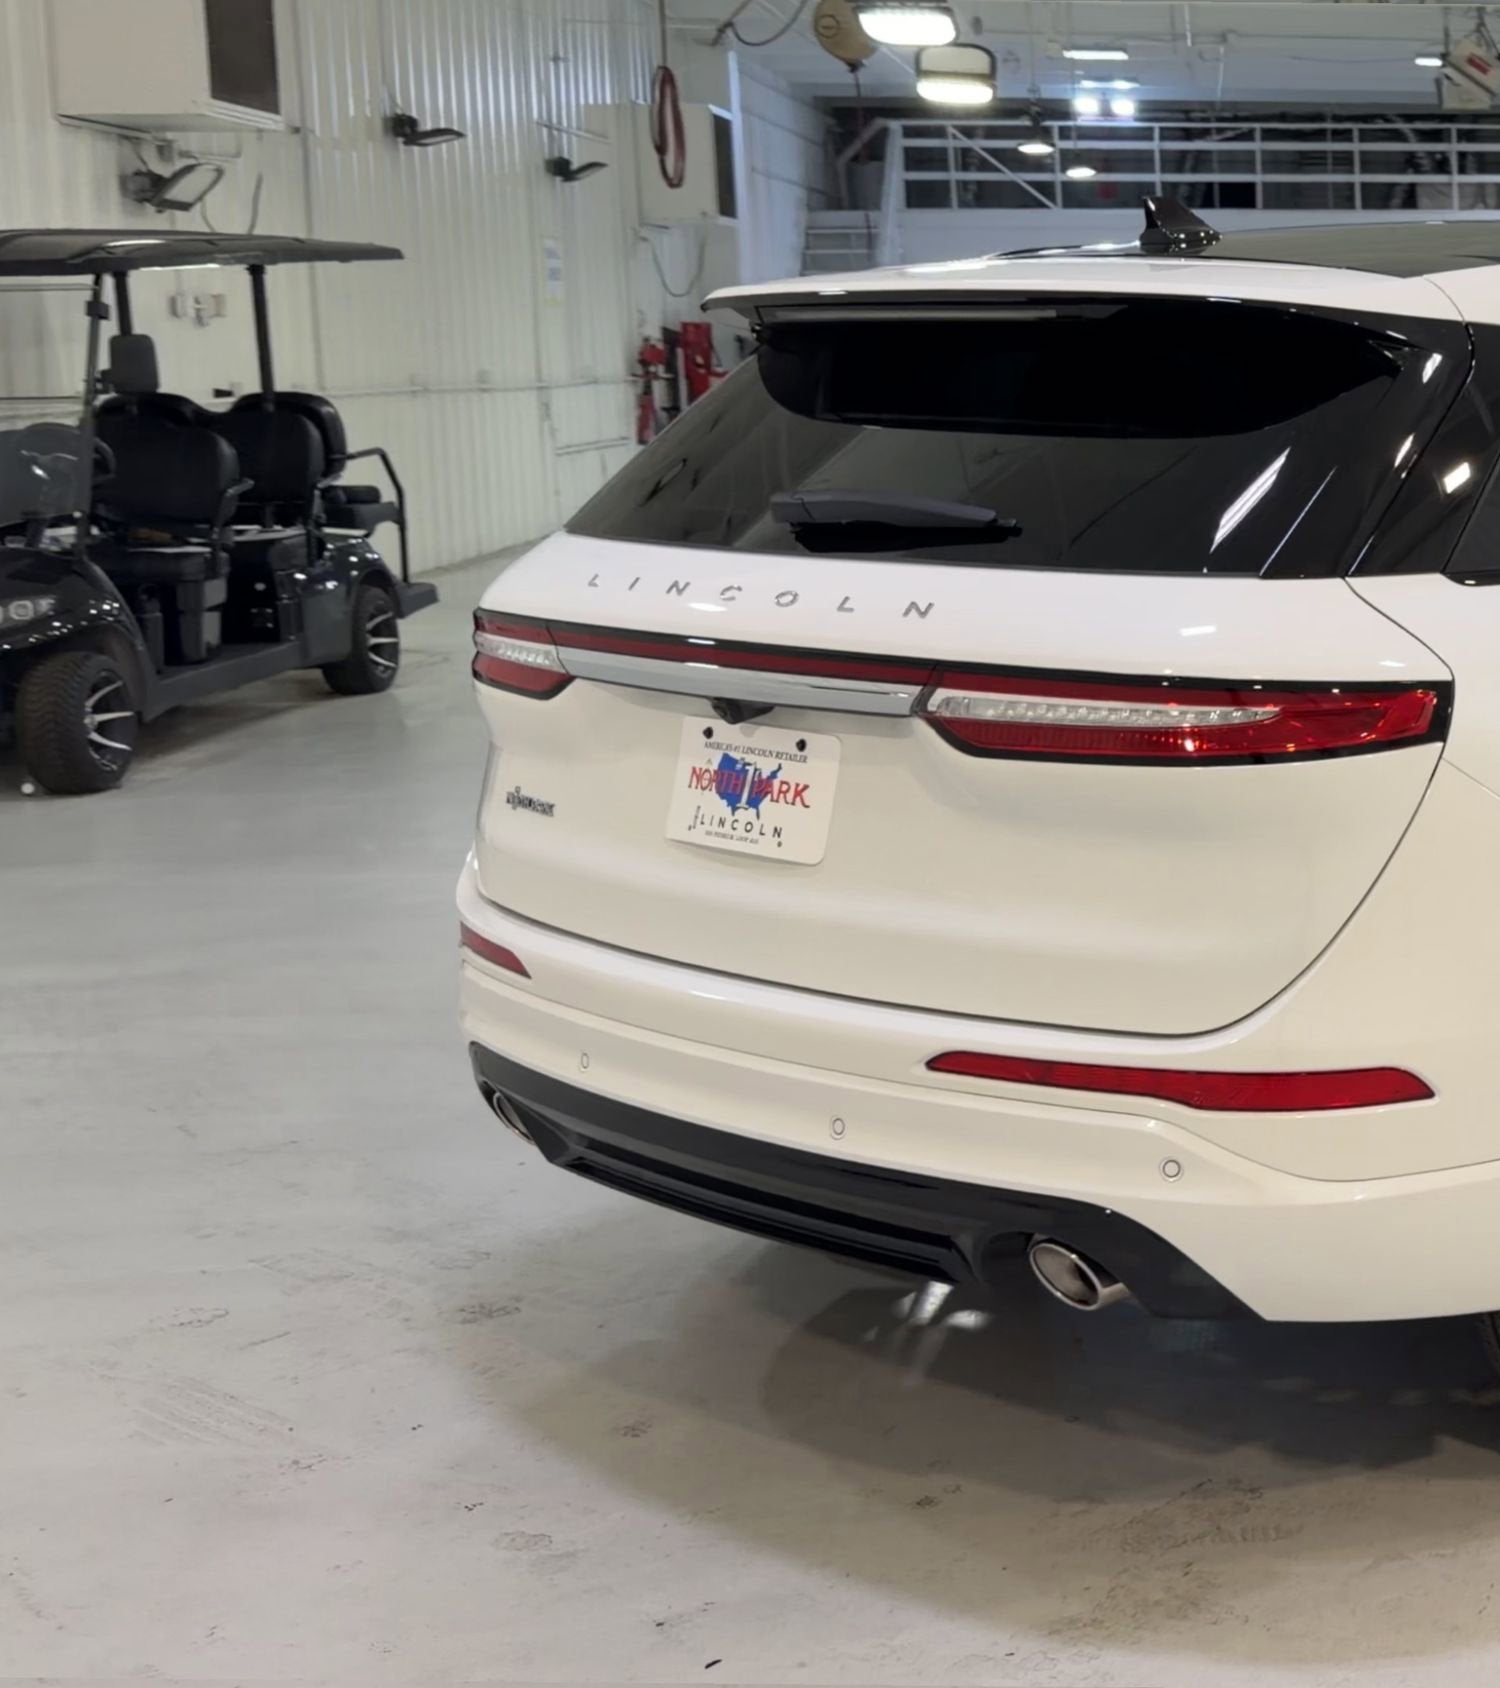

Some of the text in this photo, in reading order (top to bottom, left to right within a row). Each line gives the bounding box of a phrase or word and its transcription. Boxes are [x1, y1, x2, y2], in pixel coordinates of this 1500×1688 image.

[587, 573, 934, 619] LINCOLN
[742, 745, 774, 758] LINCOLN
[775, 750, 808, 763] RETAILER
[688, 766, 810, 809] NORTH PARK
[700, 813, 783, 839] LINCOLN
